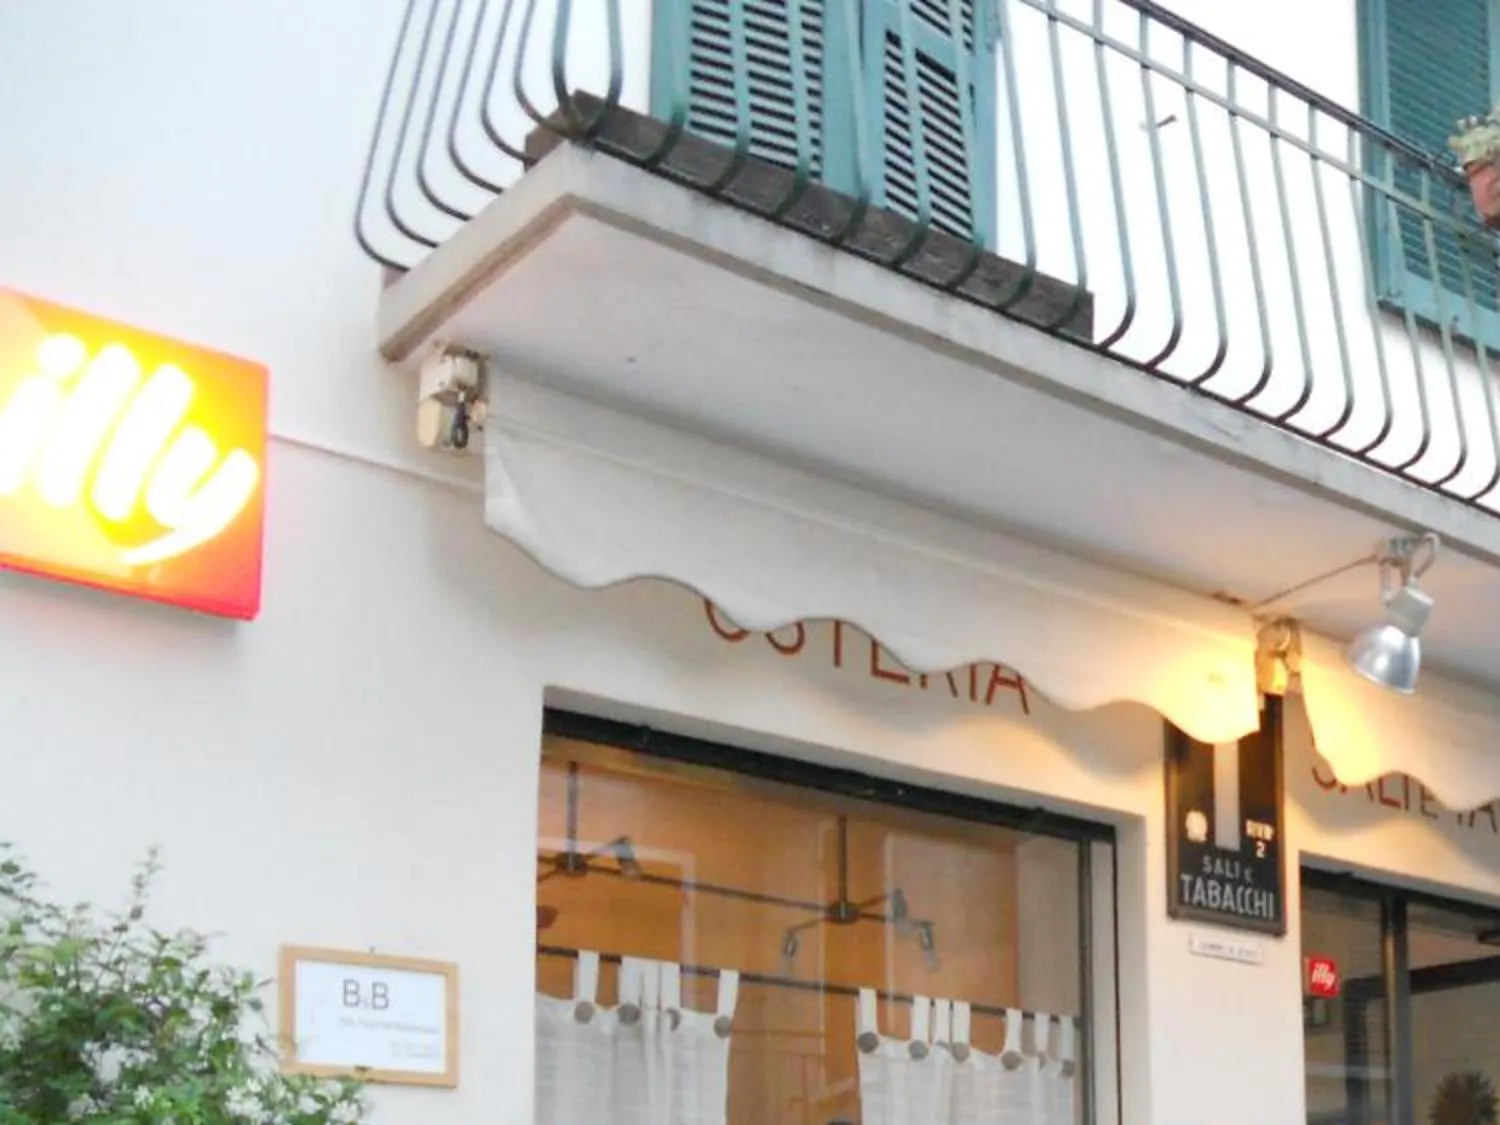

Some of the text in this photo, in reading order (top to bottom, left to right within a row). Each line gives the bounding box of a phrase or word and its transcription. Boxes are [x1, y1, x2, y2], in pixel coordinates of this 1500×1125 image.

[0, 331, 260, 567] illy
[1202, 855, 1239, 880] SALI
[1180, 872, 1274, 920] TABACCHI
[1311, 961, 1336, 991] illy
